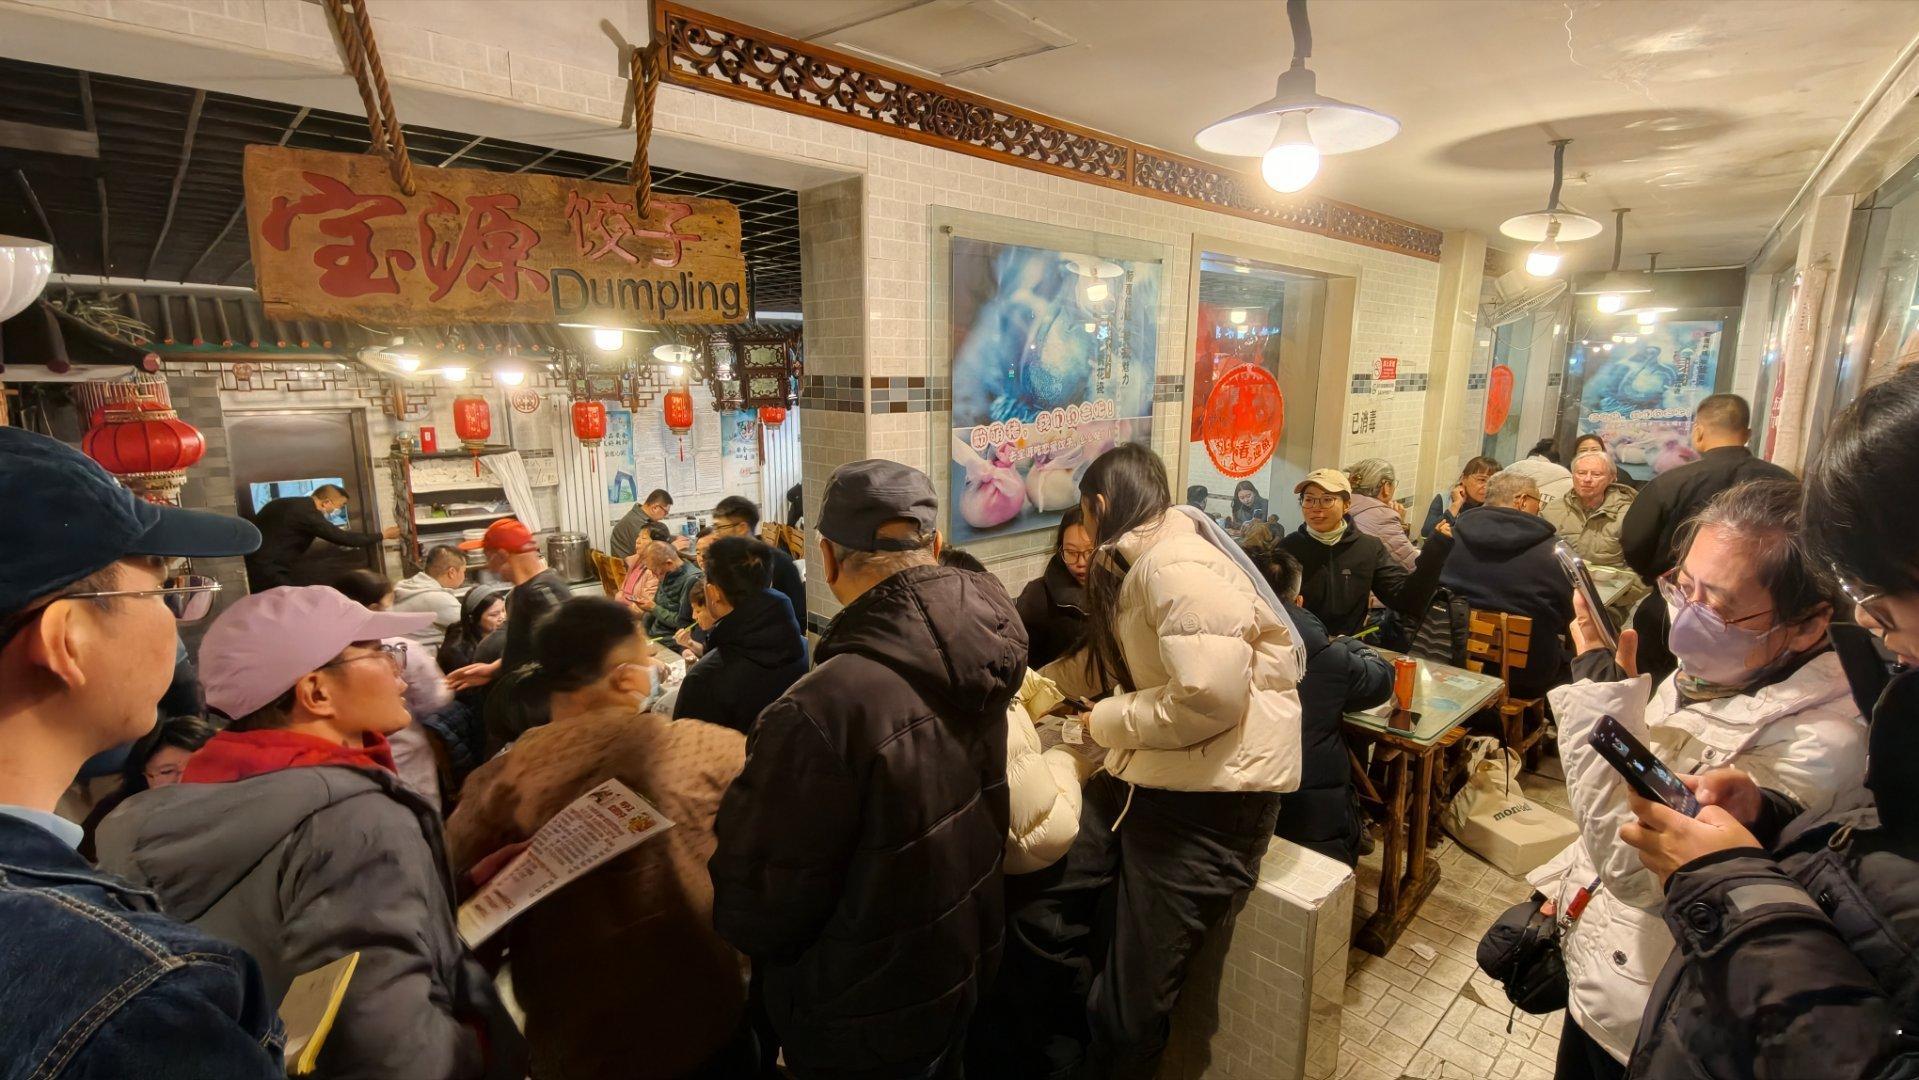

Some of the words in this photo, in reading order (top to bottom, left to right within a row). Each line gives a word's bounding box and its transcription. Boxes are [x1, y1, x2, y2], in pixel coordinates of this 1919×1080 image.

[261, 170, 551, 302] 宝源
[564, 188, 701, 269] 饺子
[549, 267, 741, 319] Dumpling
